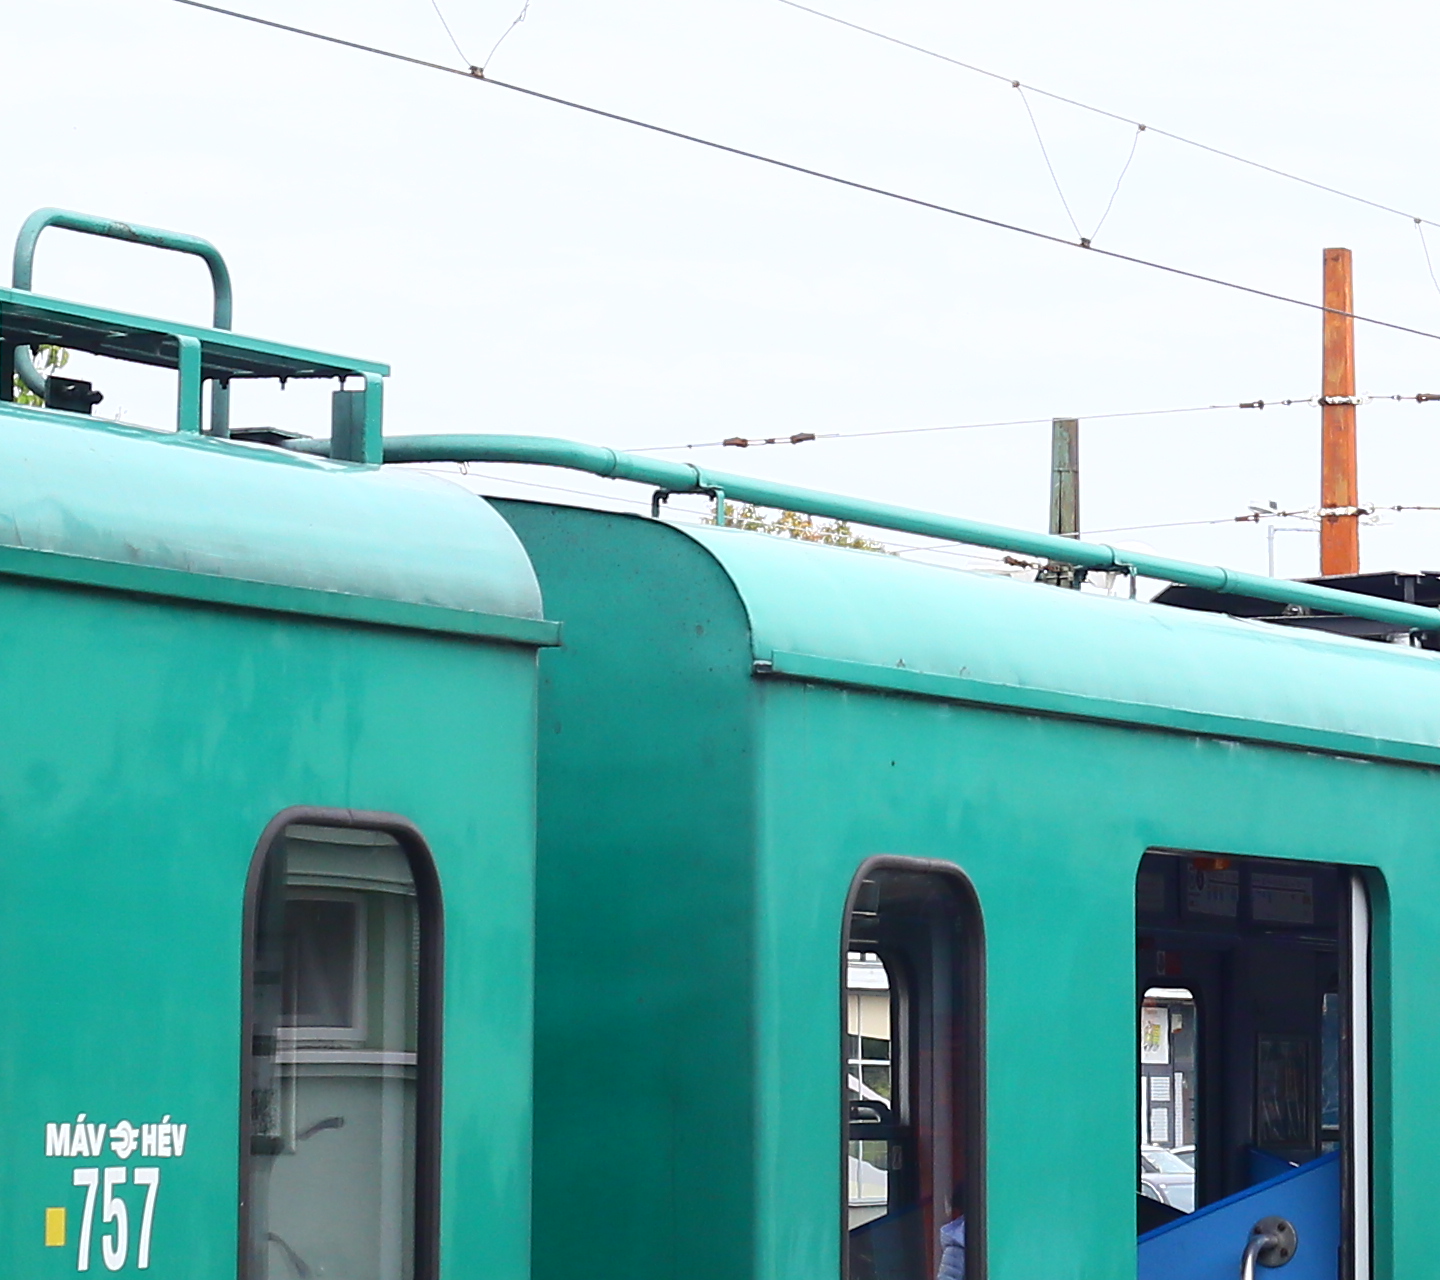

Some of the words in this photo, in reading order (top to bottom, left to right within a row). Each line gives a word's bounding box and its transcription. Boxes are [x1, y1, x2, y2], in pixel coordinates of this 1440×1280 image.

[45, 1113, 107, 1157] MÁV
[141, 1114, 188, 1157] HÉV
[73, 1166, 160, 1272] 757
